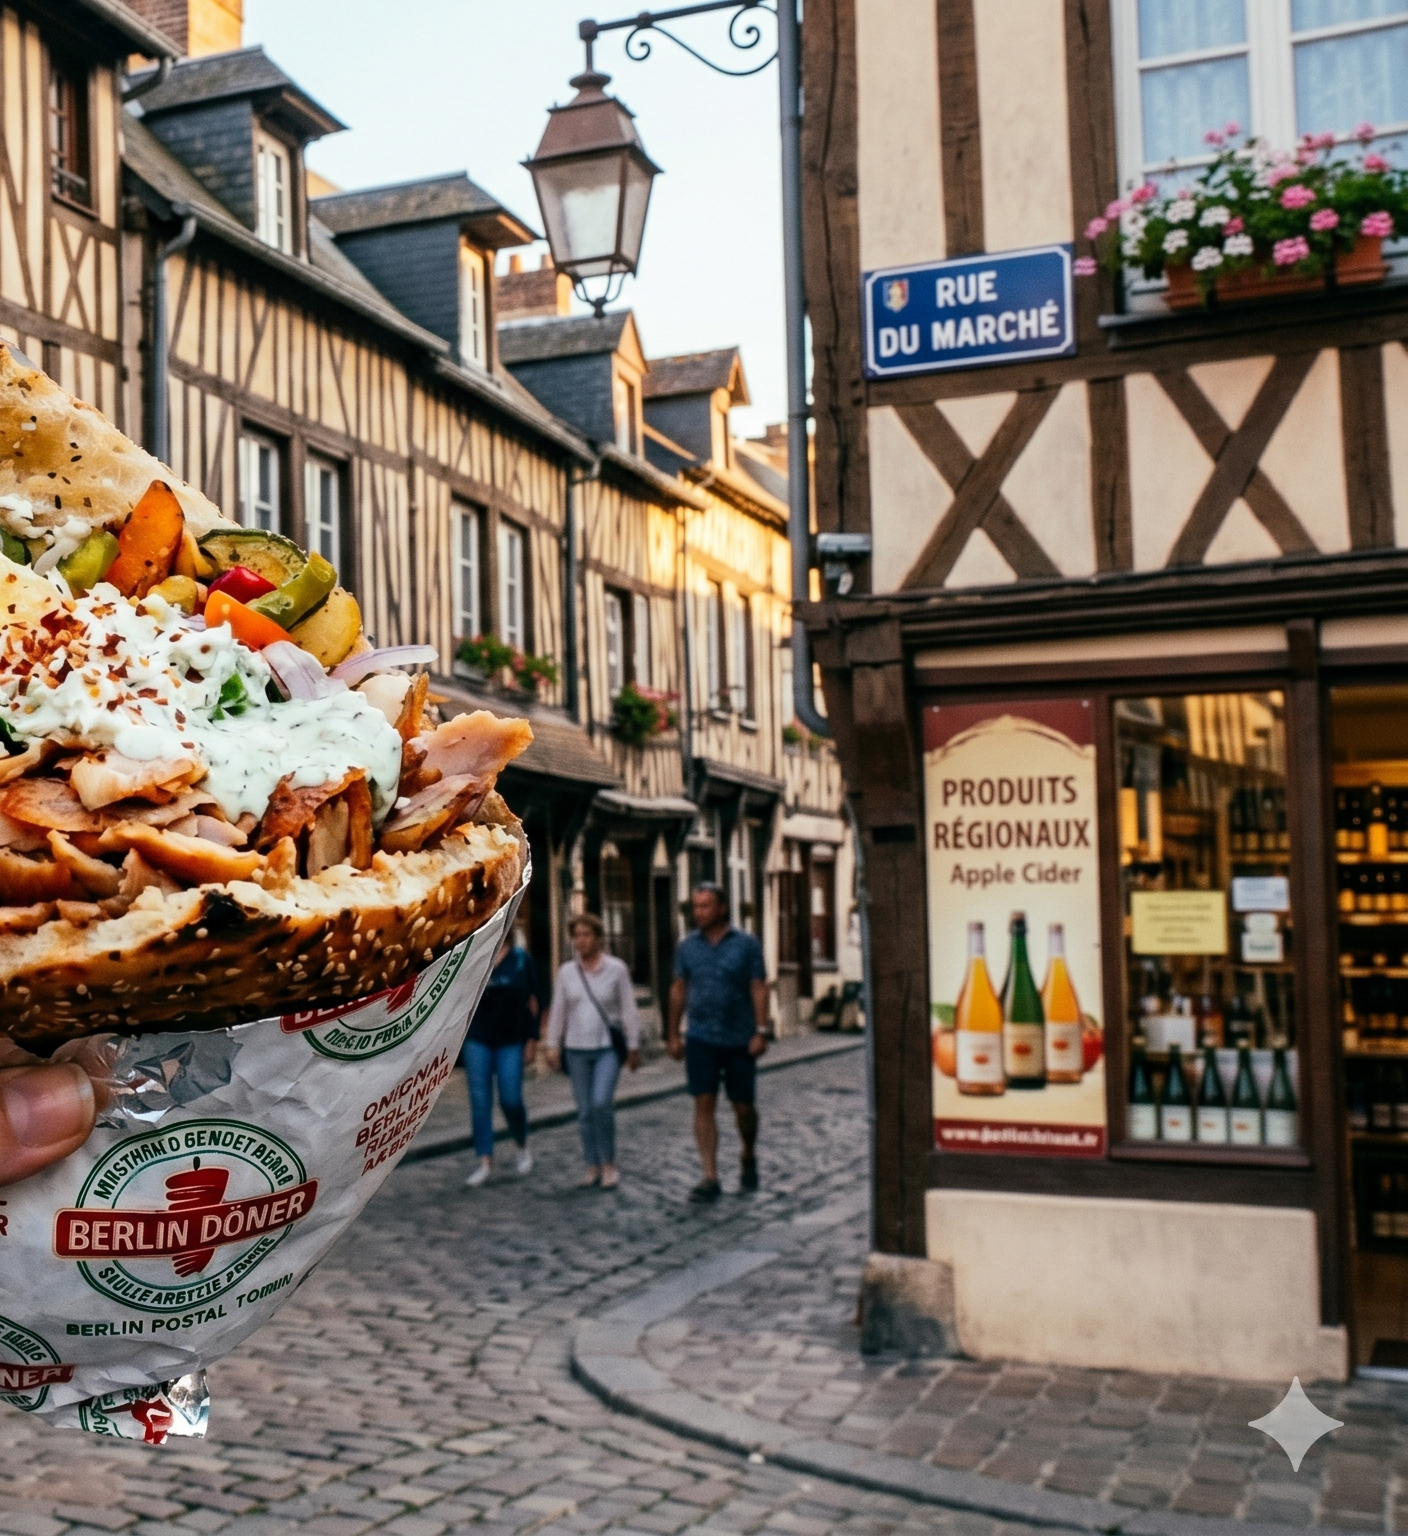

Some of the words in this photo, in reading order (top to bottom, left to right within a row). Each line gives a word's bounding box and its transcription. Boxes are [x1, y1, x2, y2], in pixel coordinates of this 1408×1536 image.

[935, 270, 998, 309] RUE
[878, 323, 921, 358] DU
[930, 299, 1061, 351] MARCHÉ
[942, 774, 1078, 807] PRODUITS
[933, 815, 1090, 850] RÉGIONAUX
[950, 861, 1016, 890] Apple
[1021, 861, 1082, 885] Cider
[68, 1219, 189, 1251] BERLIN
[199, 1191, 306, 1243] DÖNER
[66, 1320, 144, 1337] BERLIN
[151, 1304, 228, 1334] POSTAL
